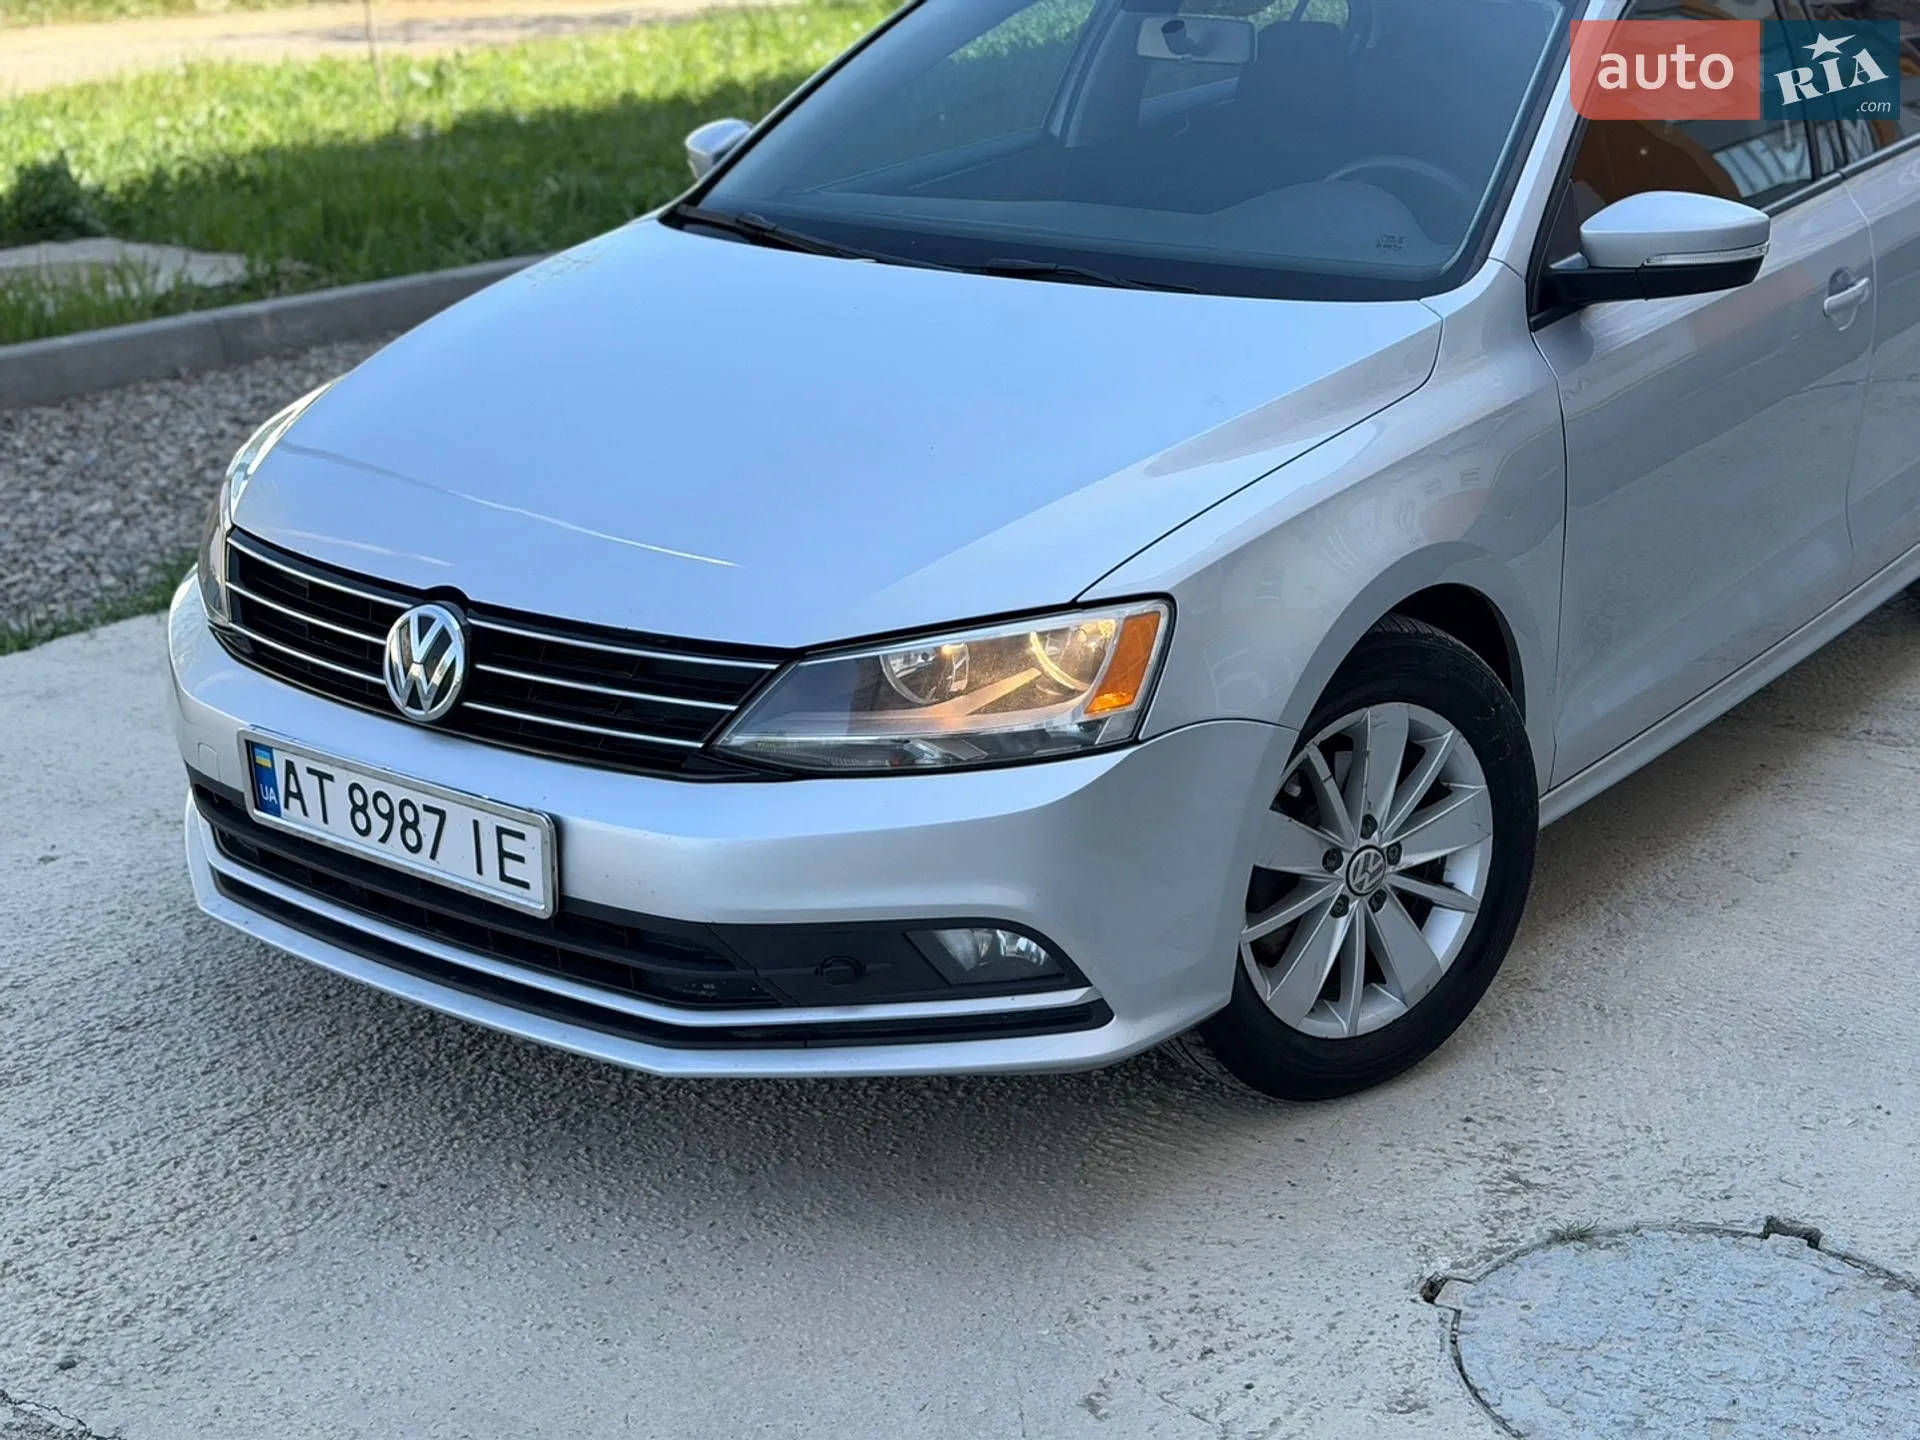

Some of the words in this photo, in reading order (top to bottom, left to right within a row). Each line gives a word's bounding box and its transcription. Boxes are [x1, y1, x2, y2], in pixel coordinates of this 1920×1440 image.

[260, 785, 278, 804] UA
[283, 759, 334, 825] AT
[348, 782, 447, 861] 8987
[472, 818, 531, 890] IE
